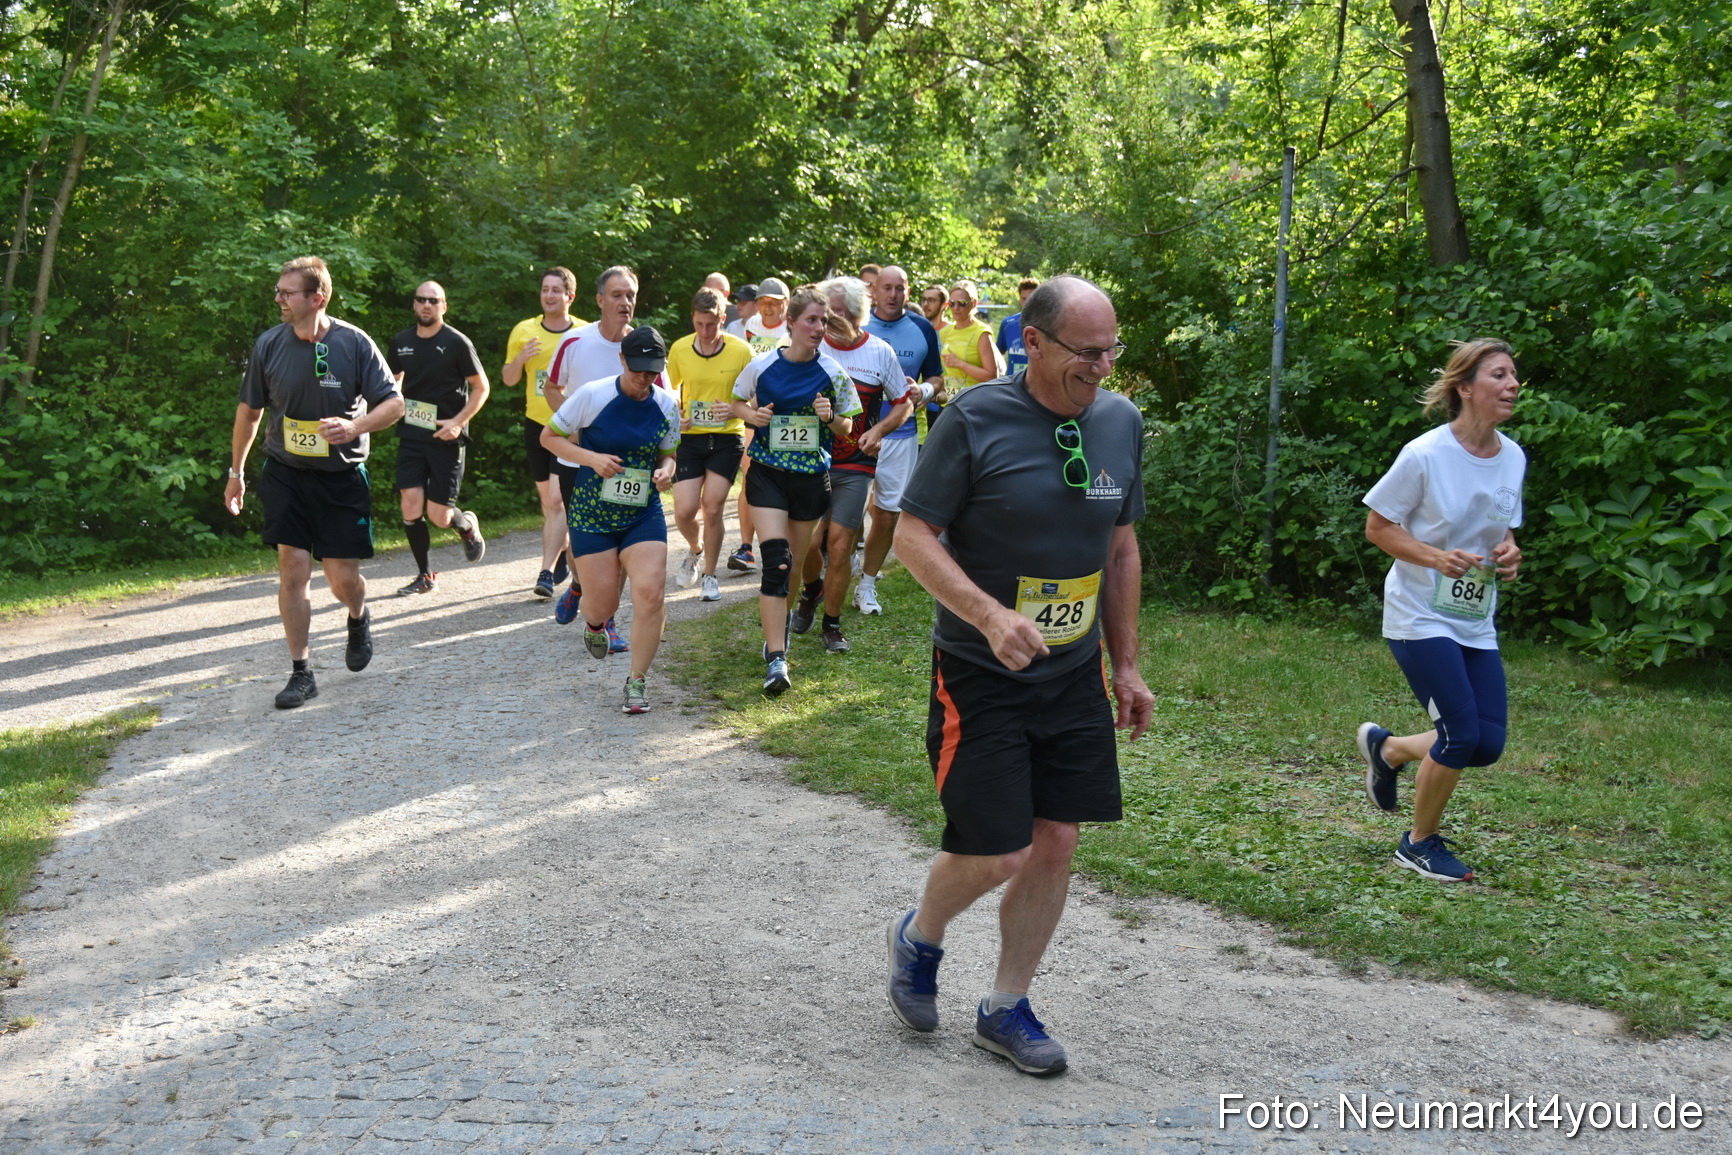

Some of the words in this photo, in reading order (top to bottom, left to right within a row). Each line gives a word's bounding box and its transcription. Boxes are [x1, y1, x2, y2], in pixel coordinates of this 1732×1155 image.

[847, 366, 876, 376] NEUMARKT
[408, 408, 433, 422] 2402
[291, 432, 317, 447] 423
[780, 428, 808, 441] 212
[614, 480, 641, 496] 199
[1085, 487, 1123, 496] BURKHARDT
[1451, 579, 1485, 603] 684
[1035, 600, 1084, 628] 428
[1037, 627, 1060, 635] ellerer
[1062, 623, 1082, 633] Roland
